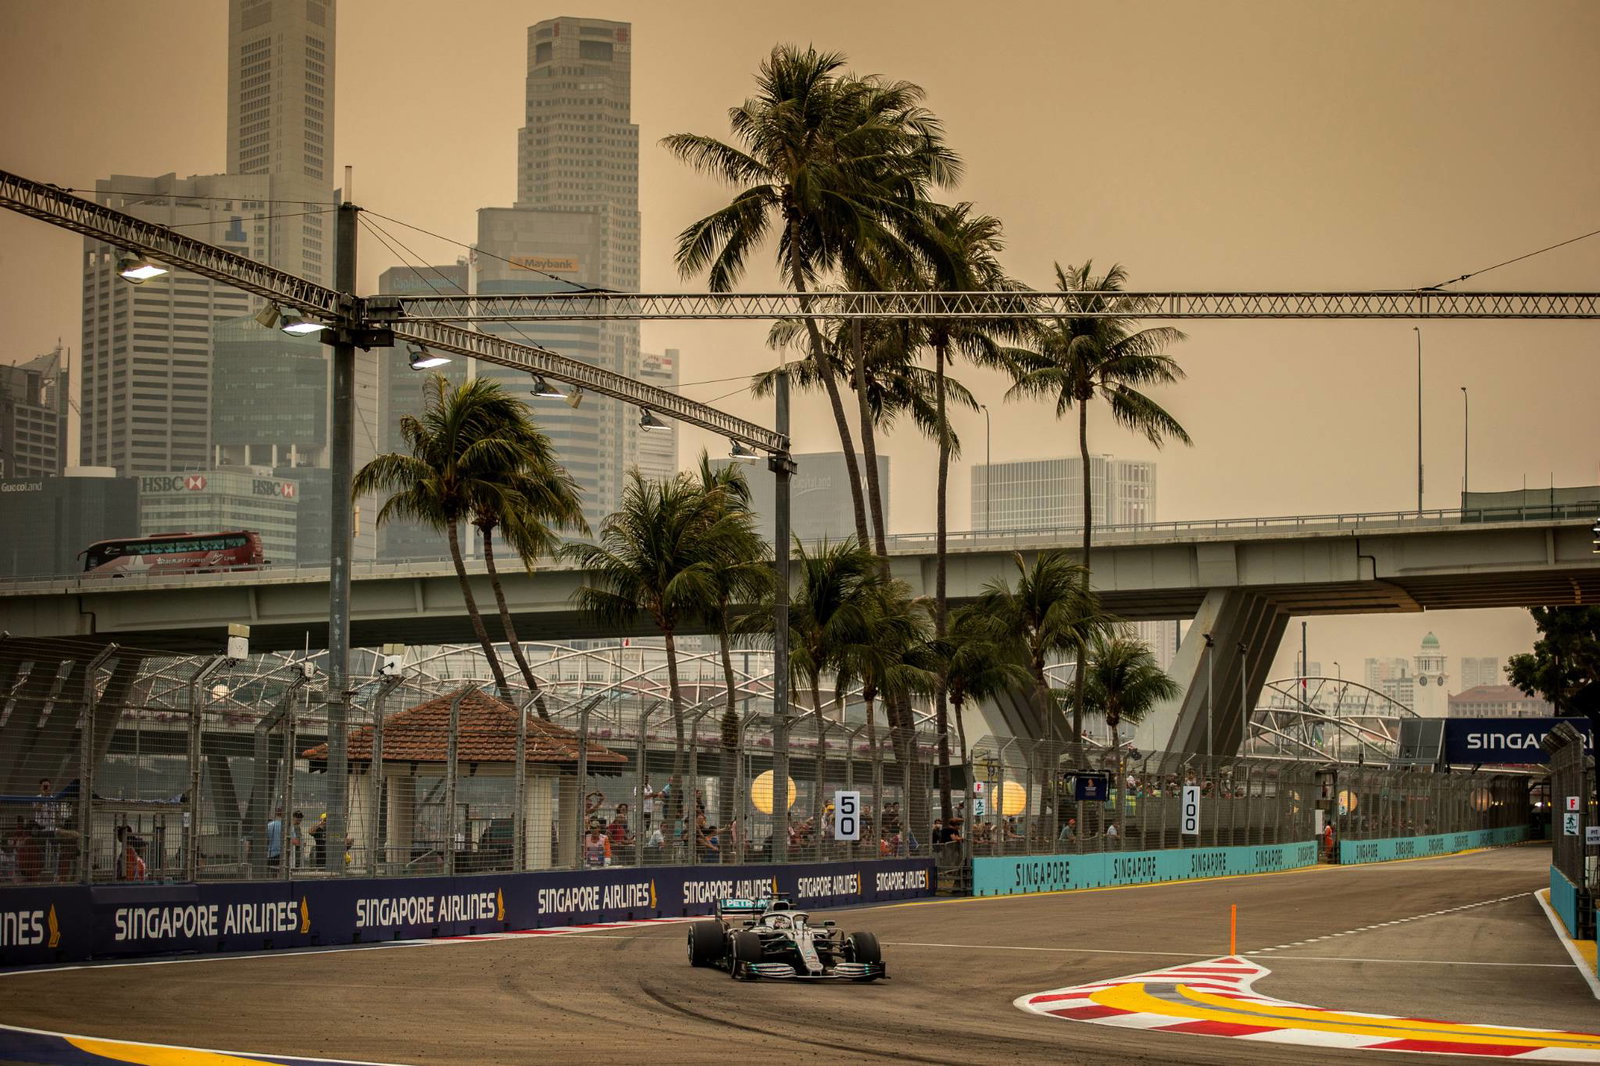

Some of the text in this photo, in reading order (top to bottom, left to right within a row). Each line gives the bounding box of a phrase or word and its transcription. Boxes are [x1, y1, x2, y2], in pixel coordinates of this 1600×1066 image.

[525, 258, 572, 269] Maybank
[142, 476, 183, 492] HSBC
[253, 479, 280, 496] HSBC
[841, 796, 854, 835] 50
[1570, 799, 1575, 808] F
[1016, 861, 1070, 886] SINGAPORE
[1114, 856, 1156, 879] SINGAPORE
[1191, 852, 1226, 873] SINGAPORE
[683, 879, 772, 904] SINGAPORE AIRLINES
[798, 873, 858, 898] SINGAPORE AIRLINES
[876, 869, 926, 891] SINGAPORE AIRLINES
[356, 892, 495, 927] SINGAPORE AIRLINES
[538, 883, 649, 914] SINGAPORE AIRLINES
[115, 901, 297, 941] SINGAPORE AIRLINES
